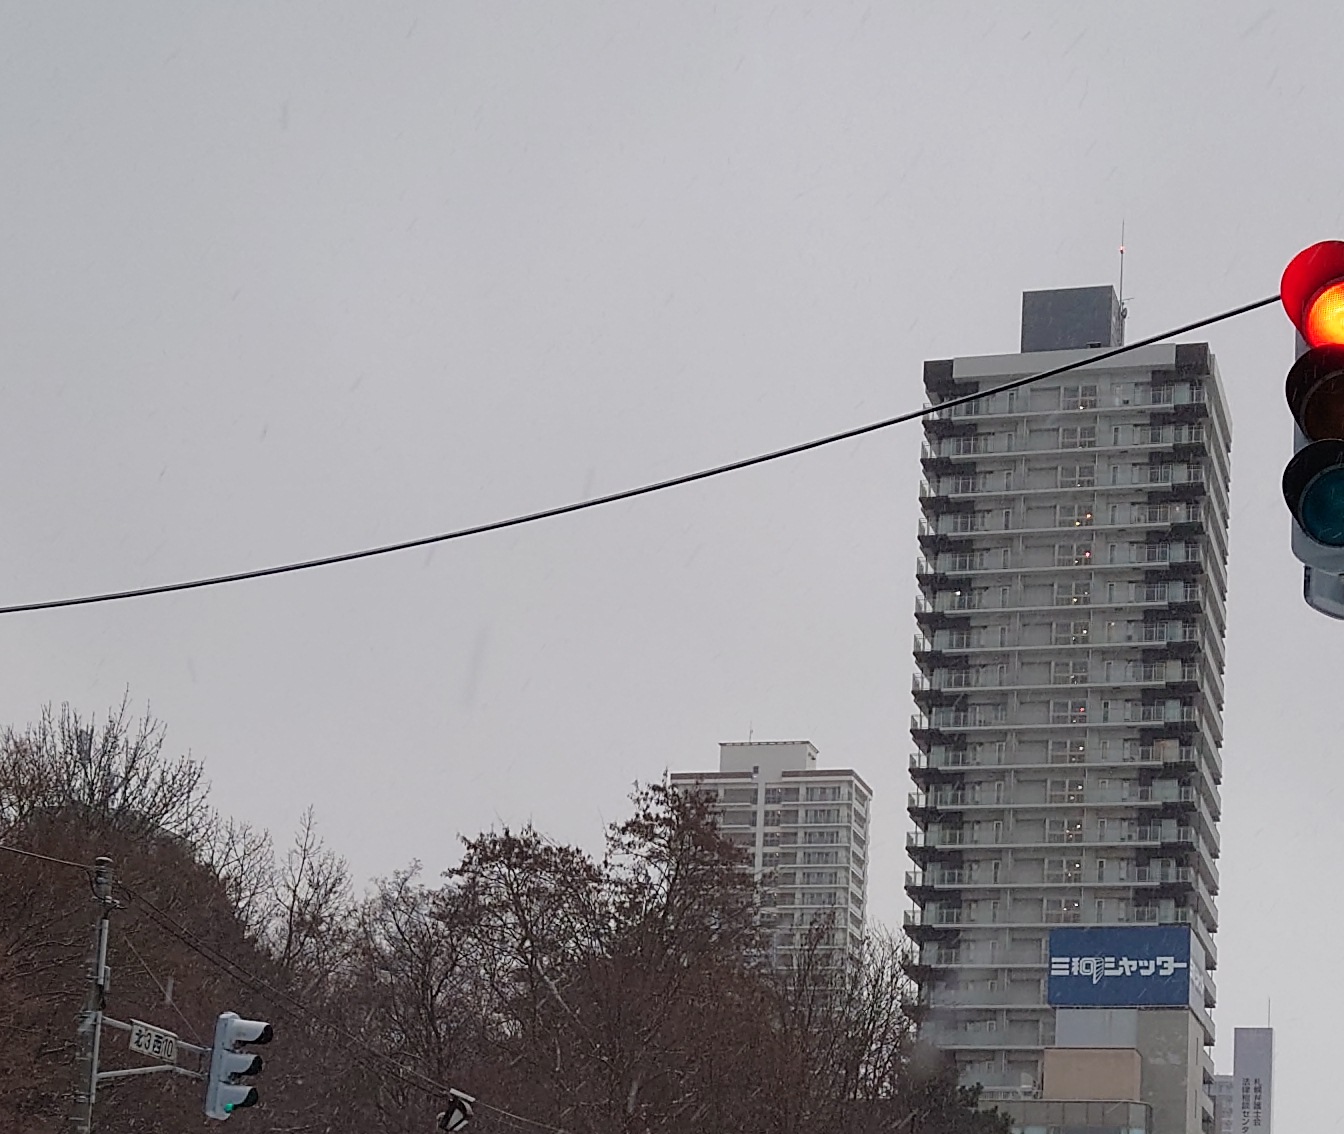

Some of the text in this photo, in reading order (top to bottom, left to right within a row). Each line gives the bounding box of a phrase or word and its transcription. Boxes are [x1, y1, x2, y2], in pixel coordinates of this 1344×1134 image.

[1051, 956, 1188, 985] 三和シャッター
[134, 1029, 173, 1058] 北3西10
